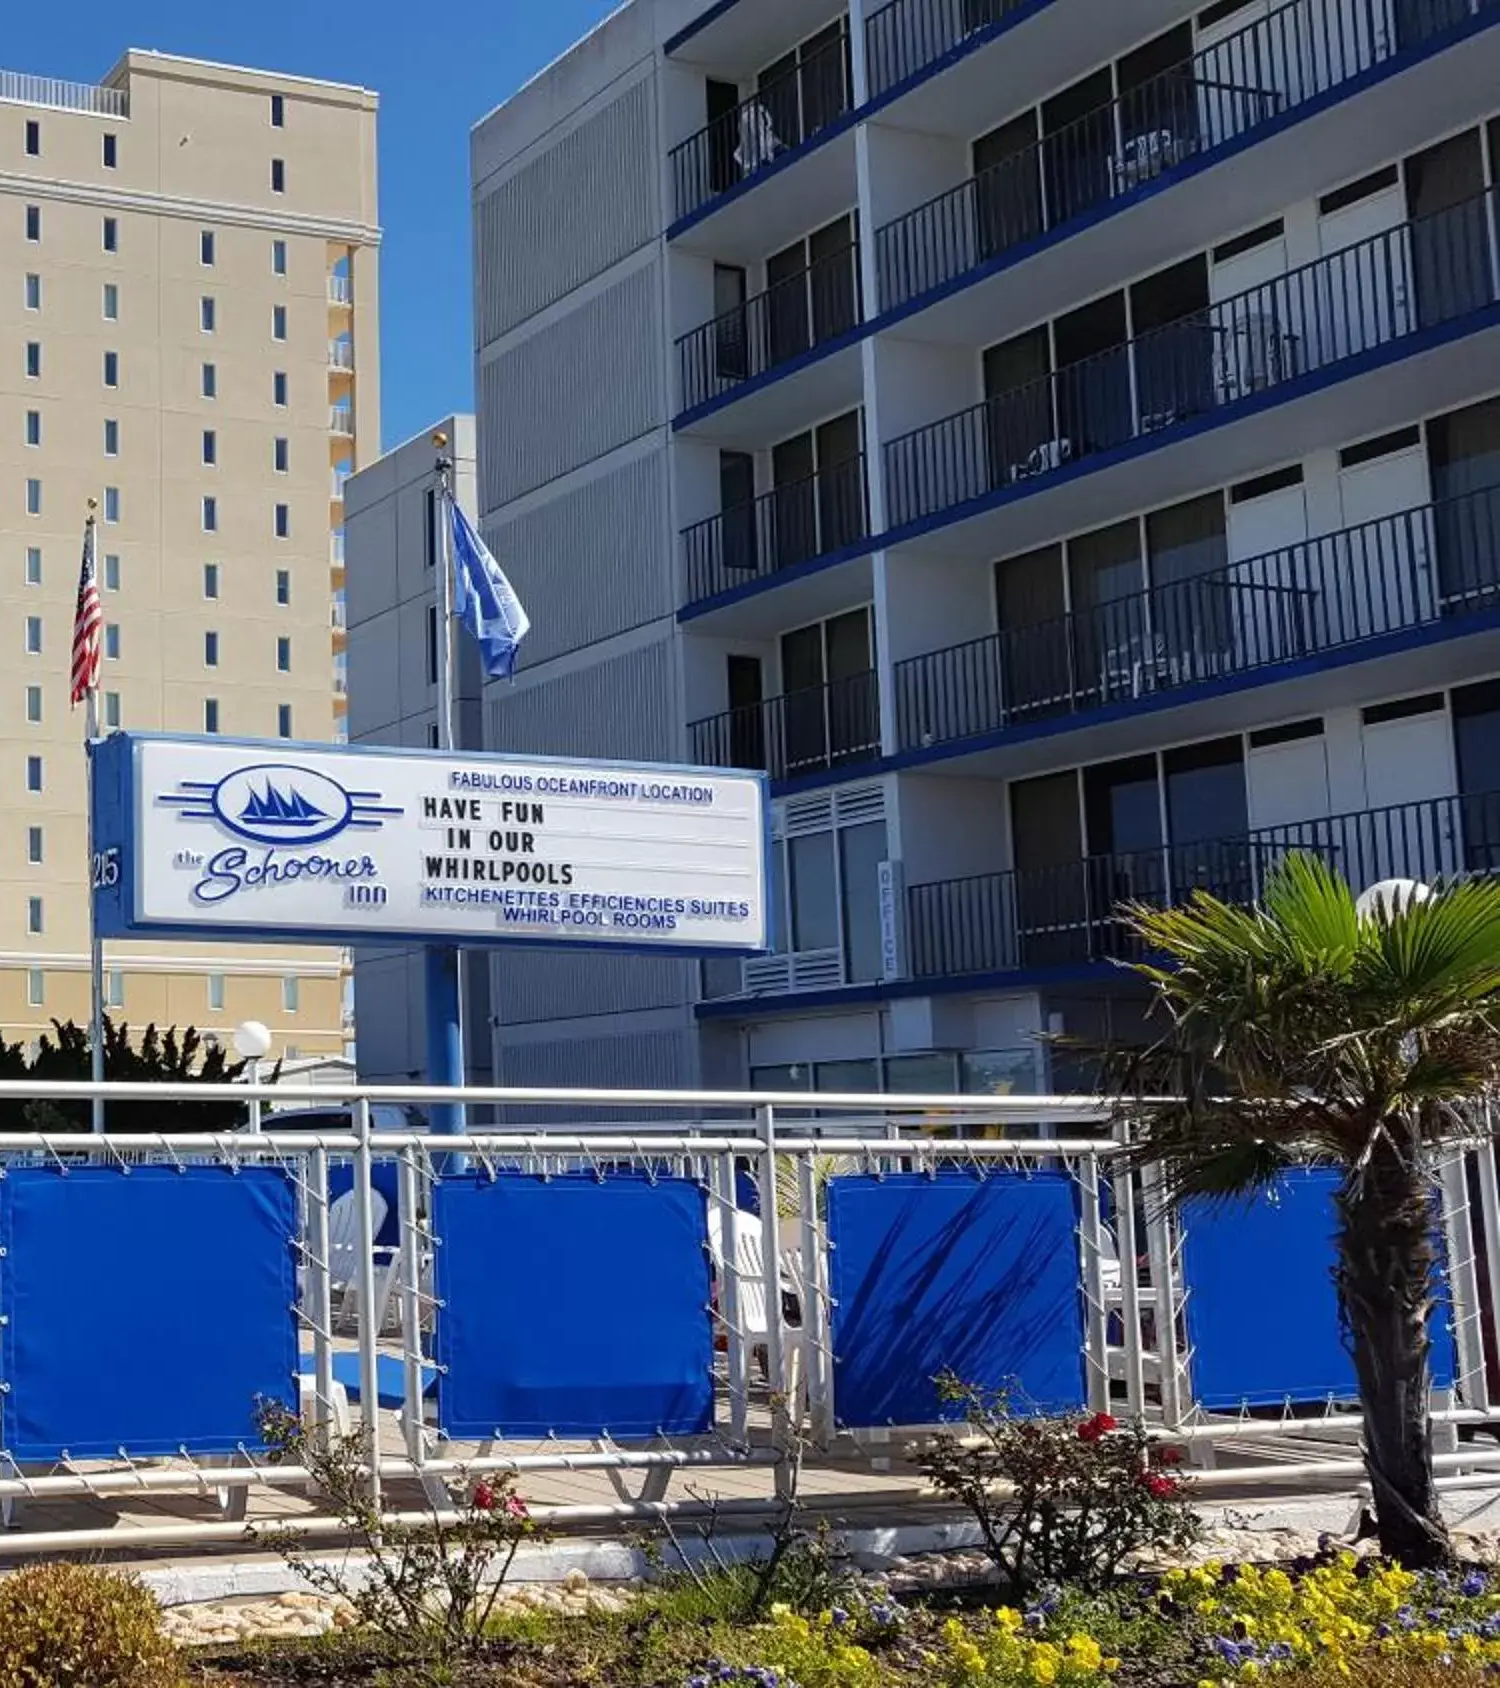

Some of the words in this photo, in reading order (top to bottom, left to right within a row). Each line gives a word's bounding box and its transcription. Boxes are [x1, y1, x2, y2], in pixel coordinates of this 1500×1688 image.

[452, 771, 533, 791] FABULOUS
[537, 776, 638, 797] OCEANFRONT
[641, 784, 713, 803] LOCATION
[423, 796, 482, 820] HAVE
[502, 801, 544, 824] FUN
[448, 827, 471, 849] IN
[489, 829, 535, 853] OUR
[93, 847, 119, 889] 215
[177, 850, 202, 865] the
[425, 856, 573, 885] WHIRLPOOLS
[195, 847, 378, 901] Schooner
[426, 887, 559, 907] KITCHENETTES
[569, 893, 685, 913] EFFICIENCIES
[691, 900, 749, 917] SUITES
[503, 907, 609, 926] WHIRLPOOL
[613, 914, 676, 929] ROOMS
[880, 868, 896, 972] OFFICE
